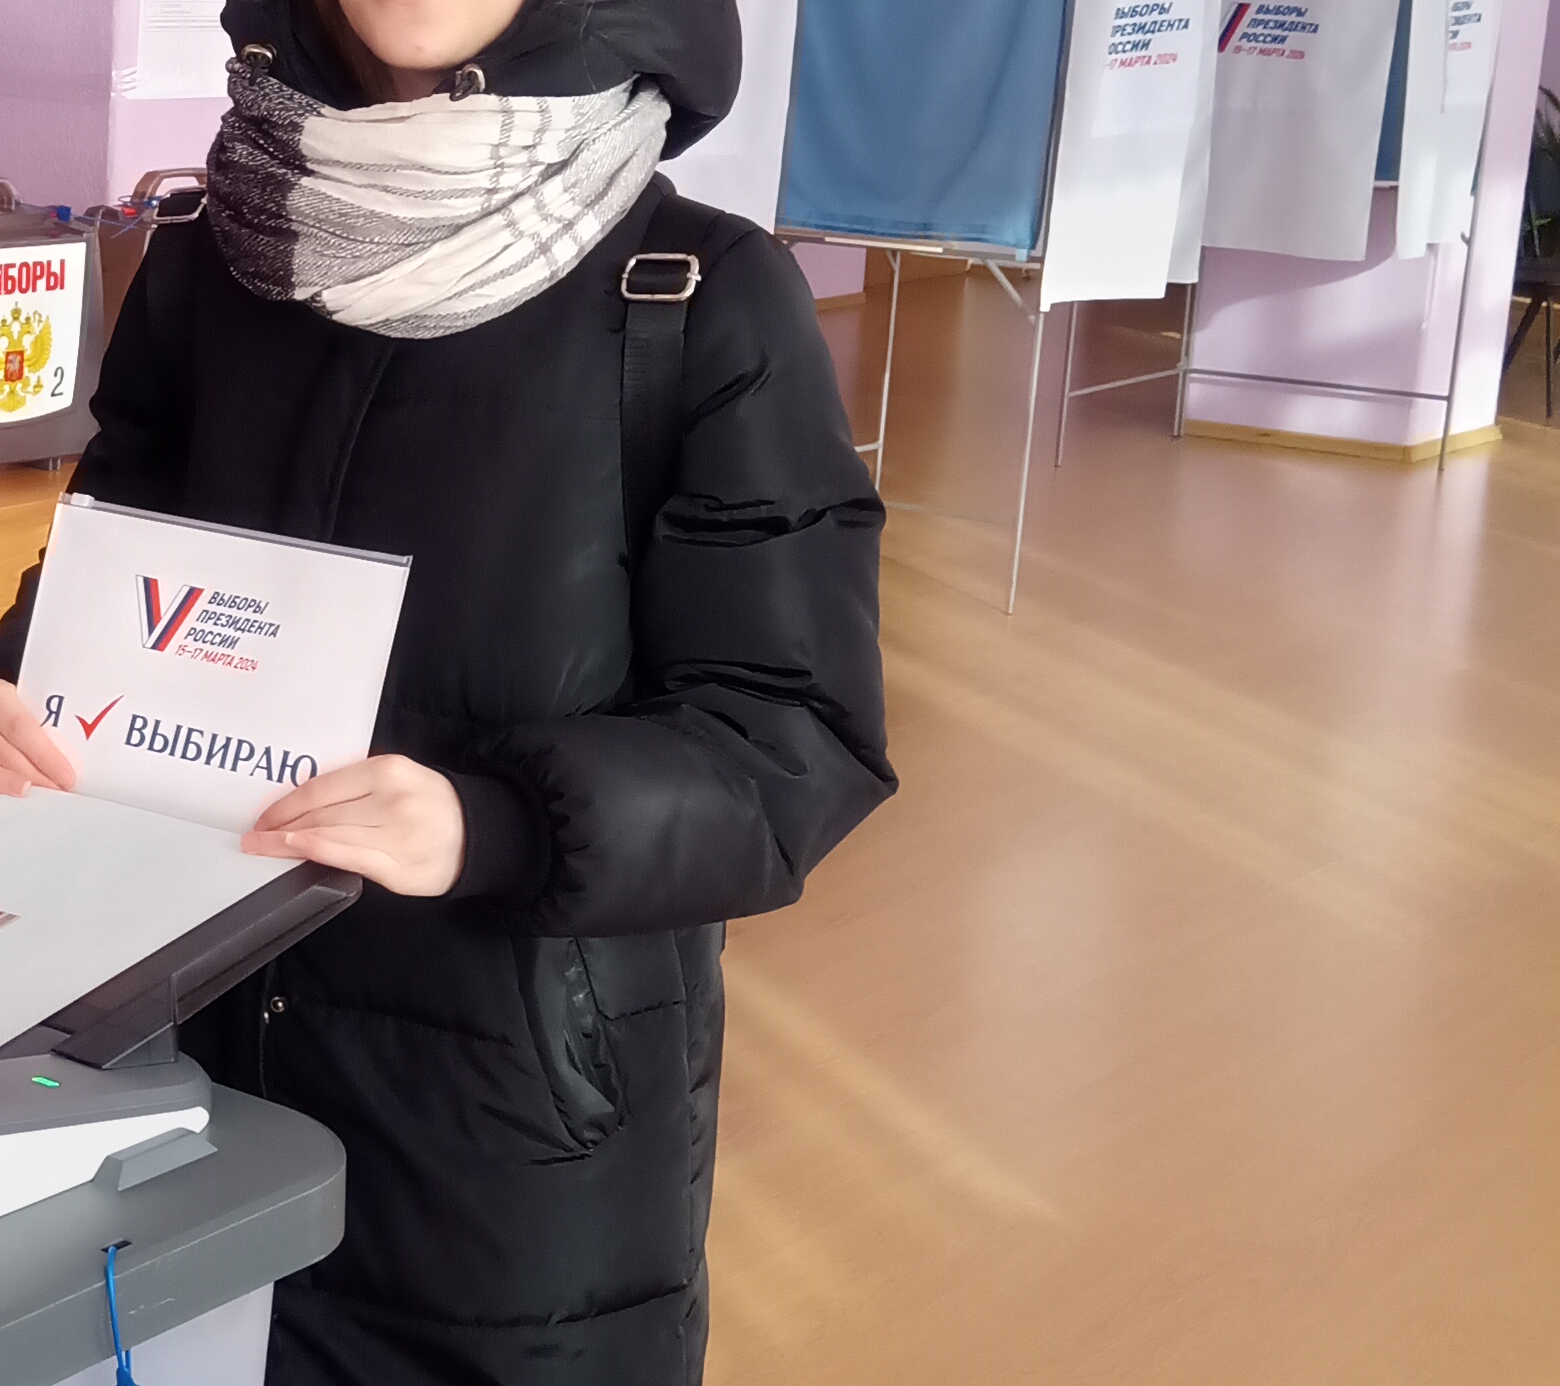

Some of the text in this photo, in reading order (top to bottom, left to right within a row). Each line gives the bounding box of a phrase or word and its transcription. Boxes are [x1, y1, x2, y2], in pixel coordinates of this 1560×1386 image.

[1255, 4, 1309, 17] ВЫБОРЫ
[1247, 18, 1320, 34] ПРЕЗИДЕНТА
[1108, 38, 1152, 55] ОССИИ
[1238, 32, 1289, 45] РОССИИ
[51, 366, 65, 397] 2
[208, 591, 270, 615] ВЫБОРЫ
[196, 609, 281, 638] ПРЕЗИДЕНТА
[184, 627, 241, 650] РОССИИ
[200, 650, 236, 667] МАРТА
[234, 657, 259, 672] 2024
[40, 694, 318, 788] Я ВЫБИРАЮ
